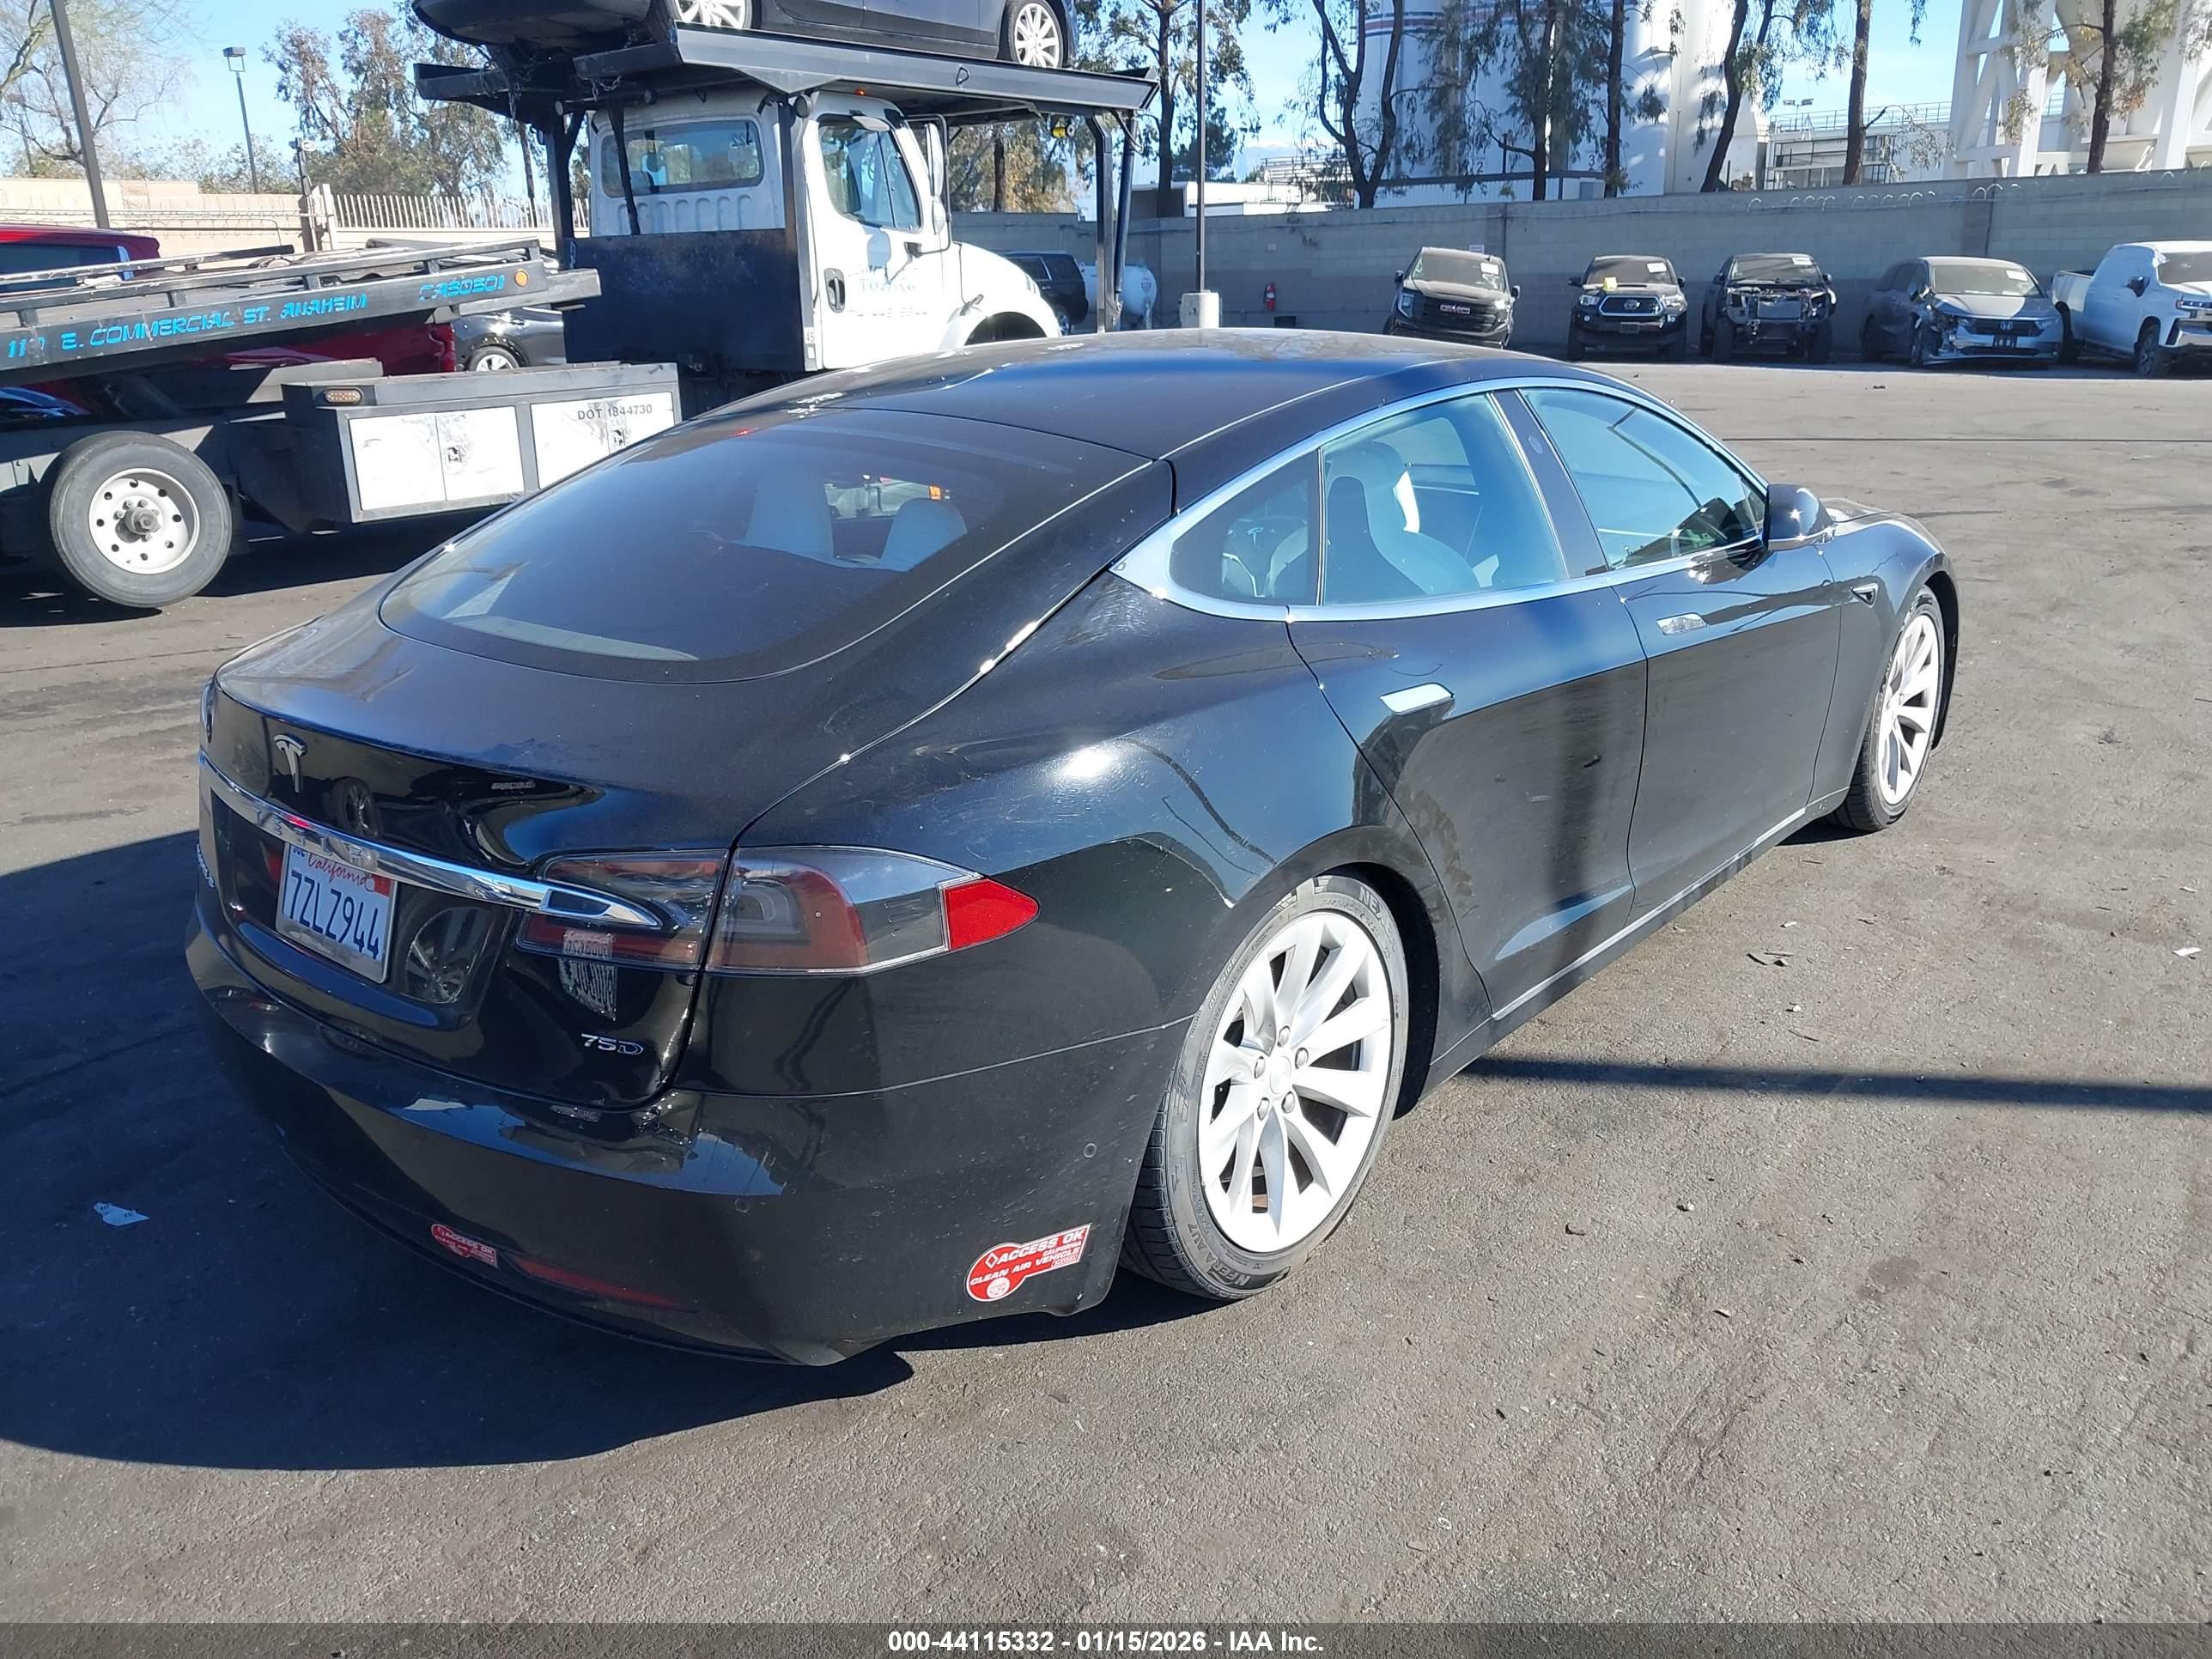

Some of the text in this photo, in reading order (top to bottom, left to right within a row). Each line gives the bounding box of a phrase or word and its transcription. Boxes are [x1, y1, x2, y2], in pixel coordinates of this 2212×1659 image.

[61, 332, 84, 350] E.
[90, 311, 234, 347] COMMERCIAL
[243, 306, 271, 324] ST.
[280, 295, 368, 319] ANAHEIM
[577, 404, 653, 420] DOT 1844730
[307, 852, 369, 887] California
[290, 869, 380, 960] 7ZLZ944
[581, 1032, 644, 1055] 75D
[481, 1245, 493, 1255] OK
[997, 1237, 1058, 1265] ACCESS
[1062, 1229, 1085, 1244] OK
[1042, 1241, 1082, 1256] CALIFORNIA
[970, 1268, 1009, 1286] CLEAN
[1012, 1261, 1032, 1274] AIR
[1036, 1247, 1080, 1267] VEHICLE
